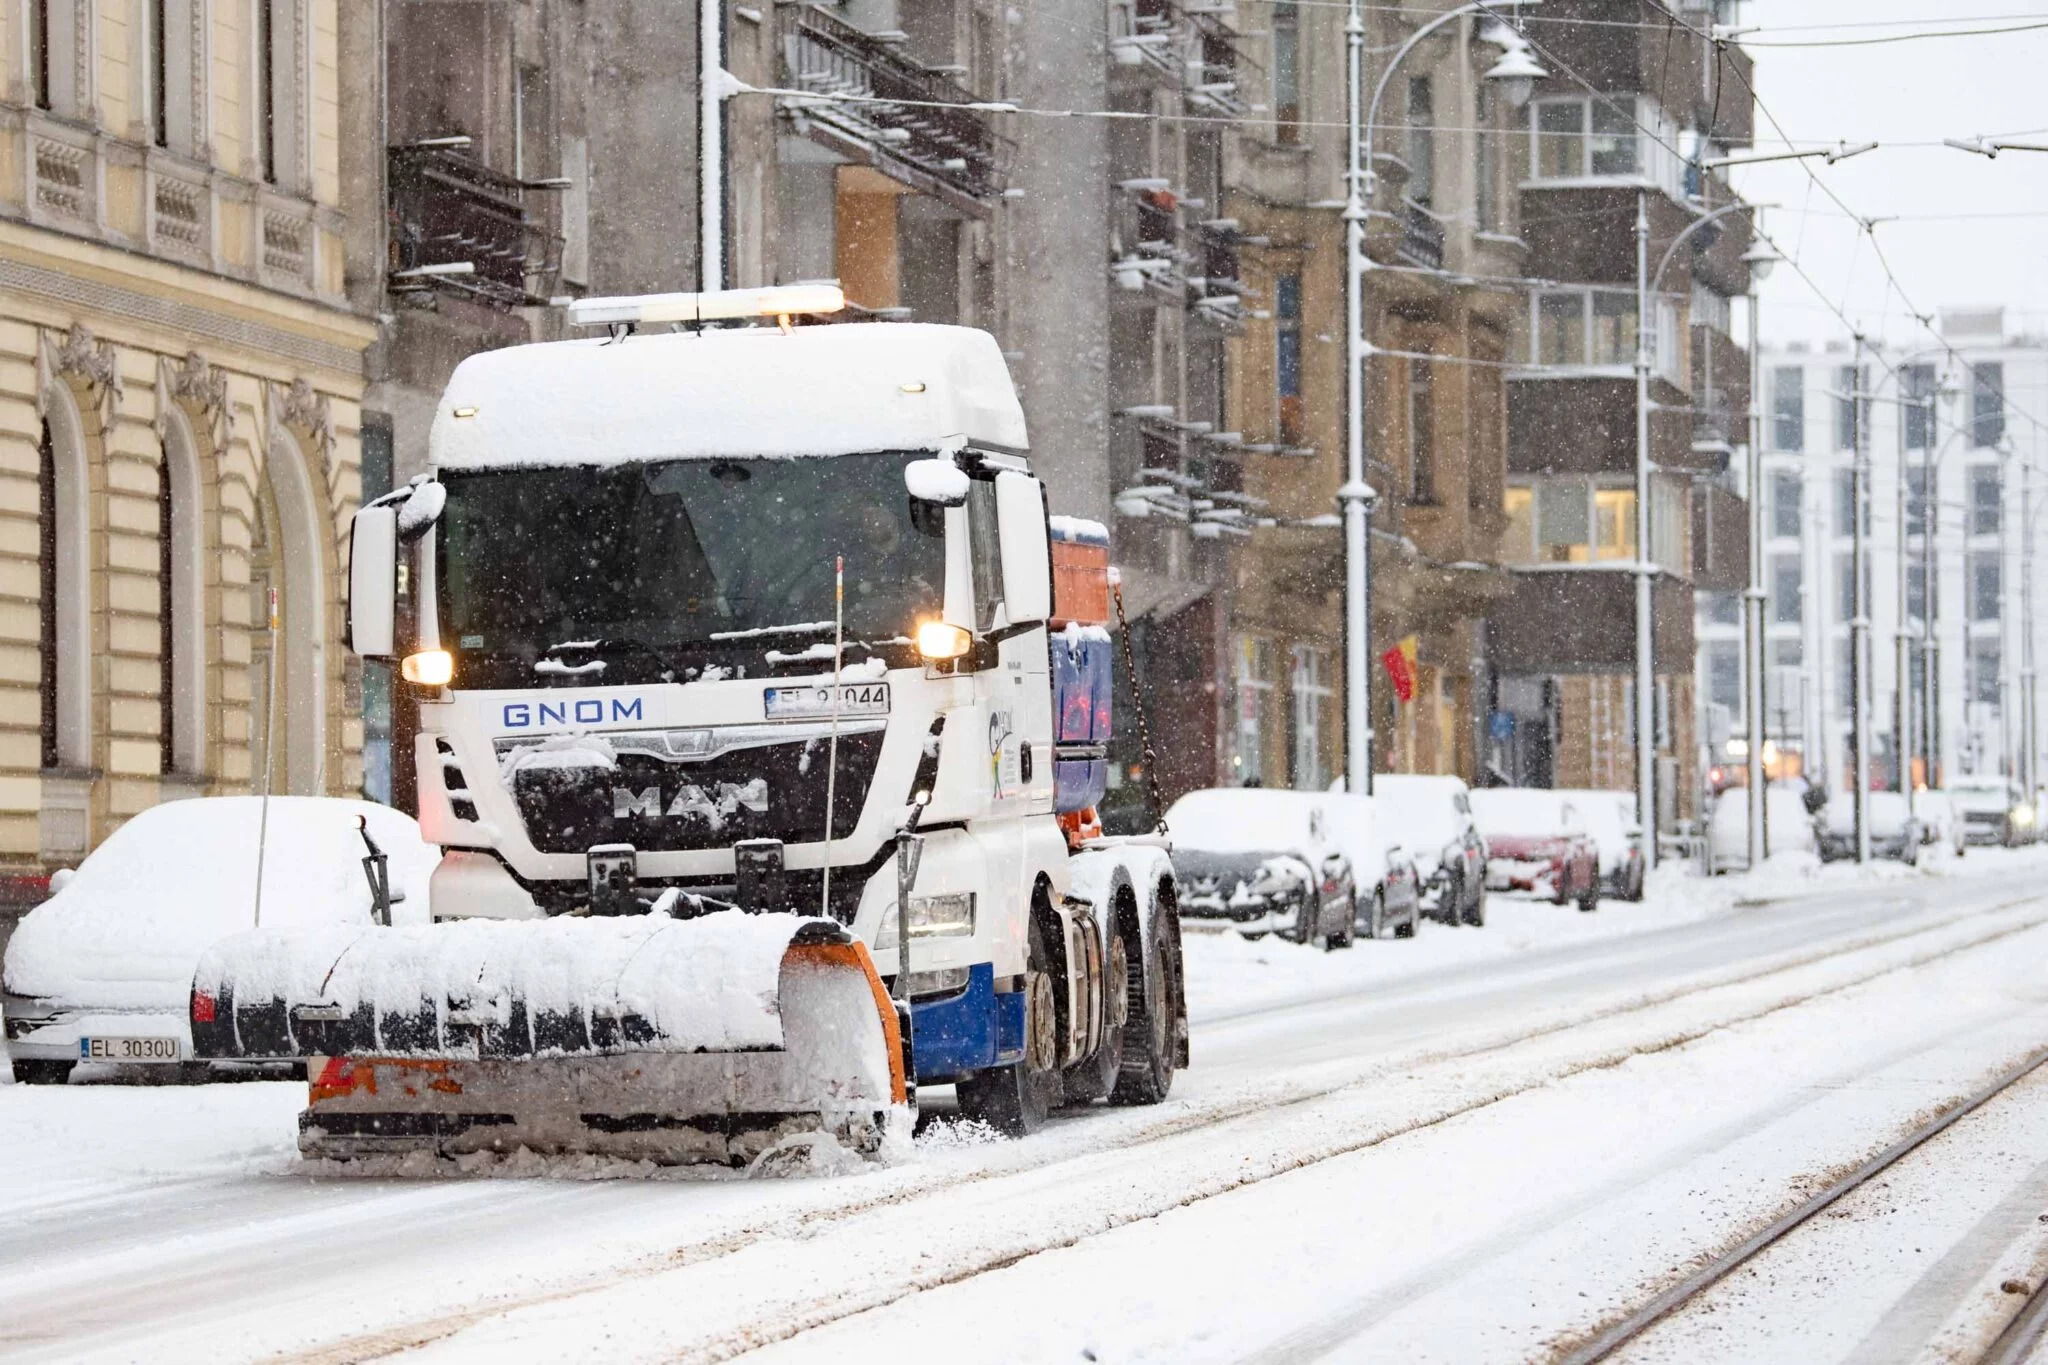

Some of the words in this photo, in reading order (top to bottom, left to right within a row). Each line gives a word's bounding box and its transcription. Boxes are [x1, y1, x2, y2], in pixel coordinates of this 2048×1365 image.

[503, 698, 642, 728] GNOM
[612, 778, 769, 823] MAN
[91, 1039, 115, 1057] EL
[121, 1039, 175, 1058] 3030U
